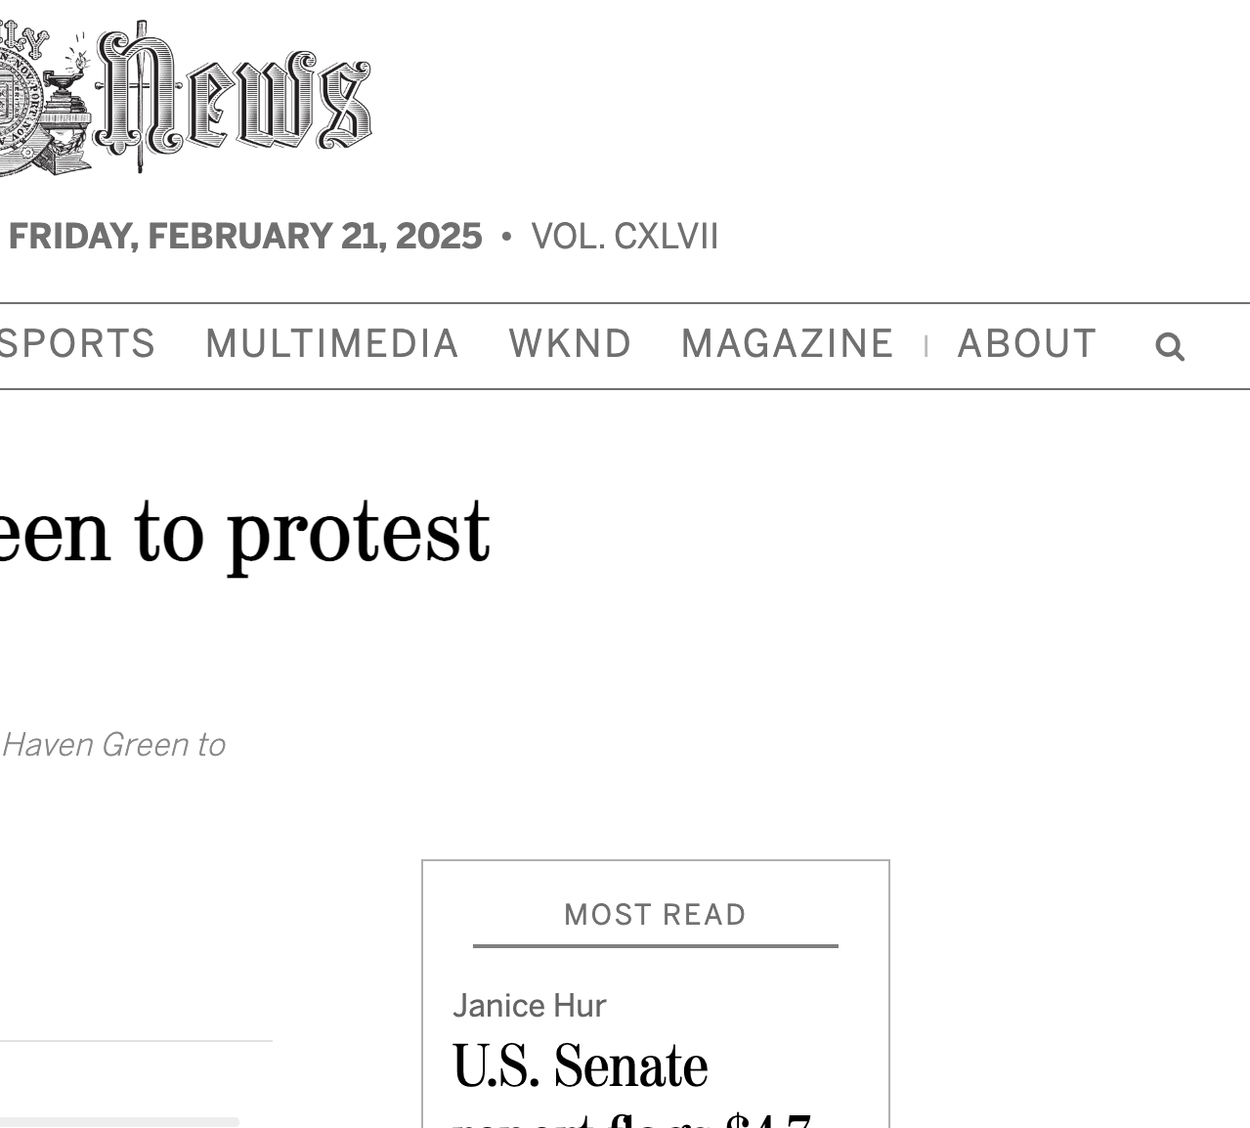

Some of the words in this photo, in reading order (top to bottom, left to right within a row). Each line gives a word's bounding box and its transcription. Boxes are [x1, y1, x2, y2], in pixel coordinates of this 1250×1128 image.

[92, 31, 373, 156] News
[10, 222, 138, 253] FRIDAY,
[150, 222, 333, 249] FEBRUARY
[342, 222, 386, 253] 21,
[397, 222, 482, 249] 2025
[532, 222, 604, 249] VOL.
[615, 222, 716, 249] CXLVII
[208, 328, 457, 358] MULTIMEDIA
[509, 328, 629, 357] WKND
[683, 328, 892, 358] MAGAZINE
[958, 328, 1096, 358] ABOUT
[134, 500, 203, 562] to
[227, 500, 490, 578] protest
[3, 732, 93, 756] Haven
[103, 731, 189, 756] Green
[199, 733, 226, 756] to
[566, 903, 651, 925] MOST
[665, 903, 744, 925] READ
[453, 993, 544, 1017] Janice
[555, 993, 607, 1017] Hur
[452, 1043, 539, 1087] U.S.
[556, 1043, 708, 1087] Senate
